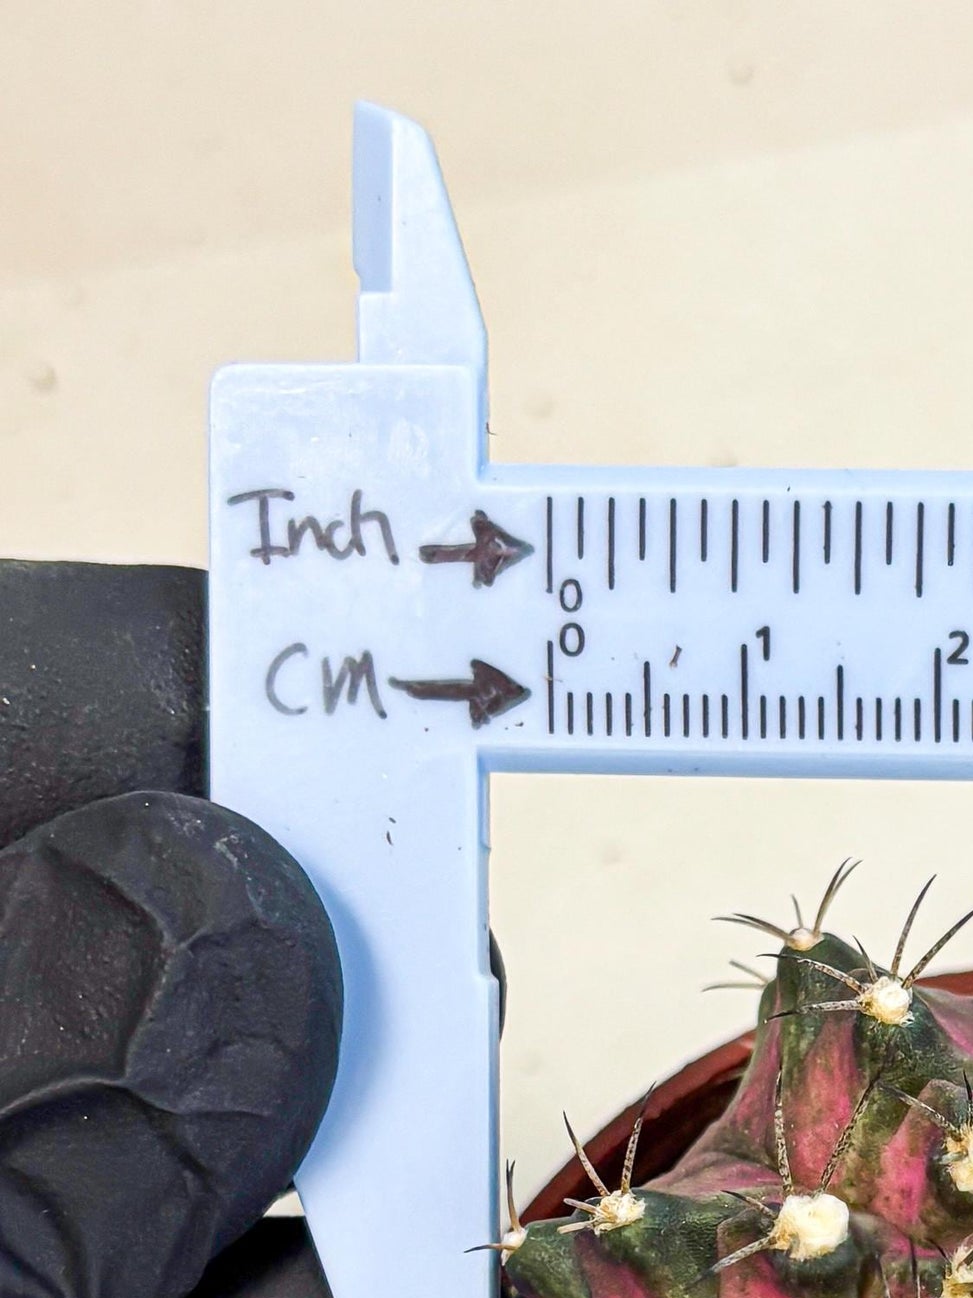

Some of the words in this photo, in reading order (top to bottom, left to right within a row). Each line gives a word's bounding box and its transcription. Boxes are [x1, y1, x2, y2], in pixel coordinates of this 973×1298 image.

[227, 488, 400, 565] Inch
[559, 578, 583, 613] 0
[559, 622, 586, 657] 0
[755, 625, 771, 662] 1
[946, 630, 970, 665] 2
